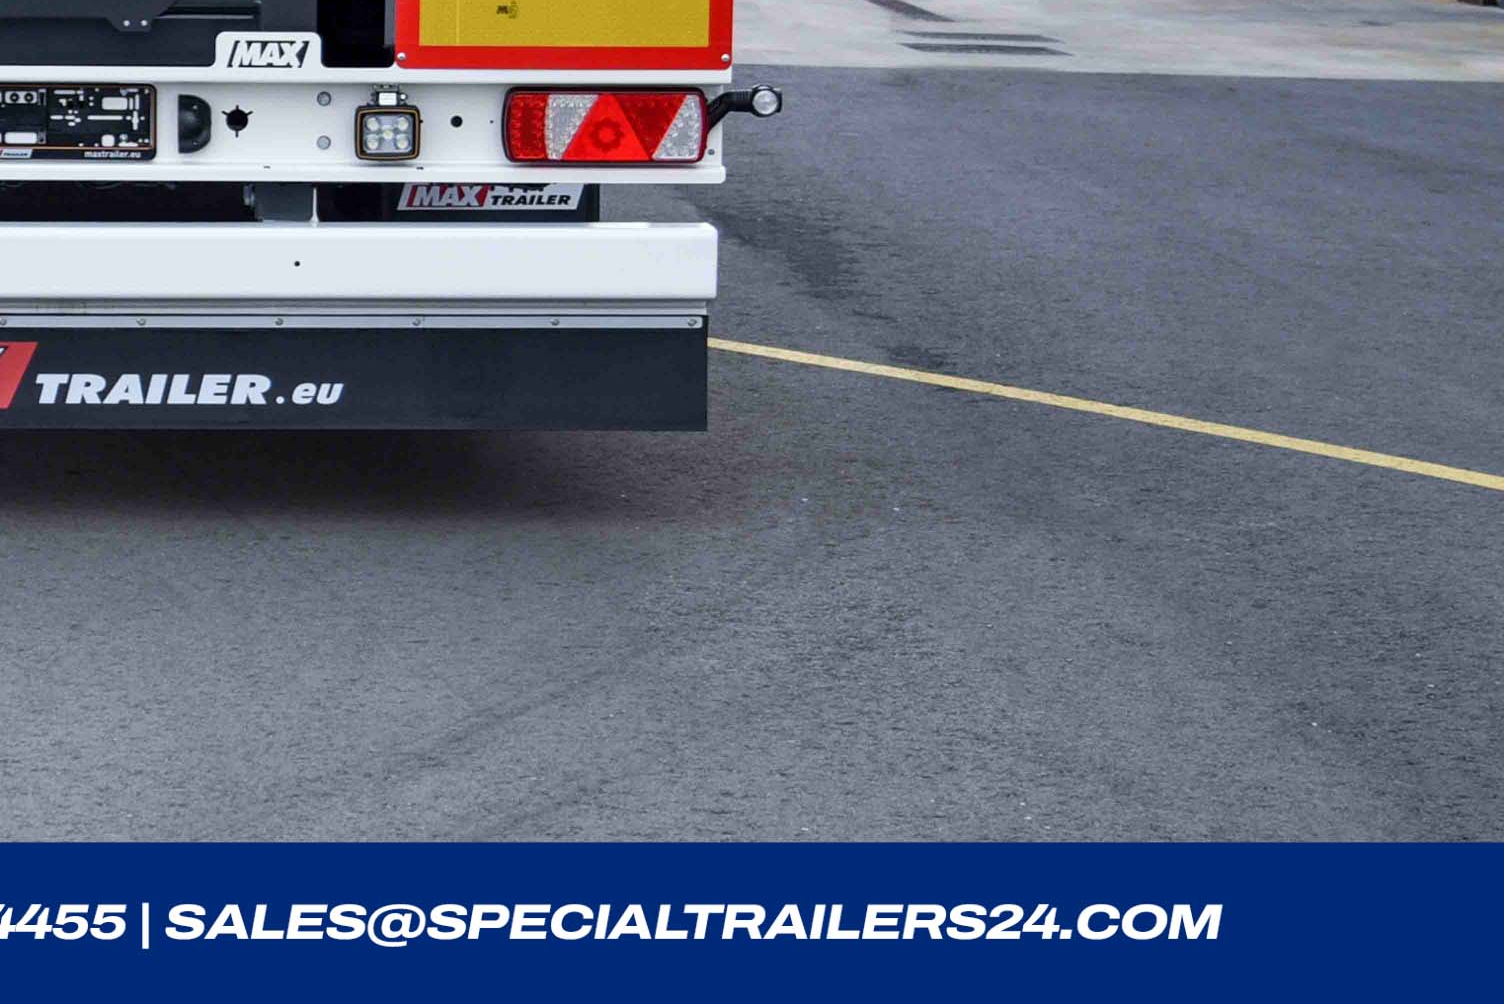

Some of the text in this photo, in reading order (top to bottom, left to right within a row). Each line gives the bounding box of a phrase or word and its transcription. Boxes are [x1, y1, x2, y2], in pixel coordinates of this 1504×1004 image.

[229, 41, 308, 68] MAX
[84, 149, 142, 159] maxtrailer.eu
[410, 184, 571, 207] MAX TRAILER
